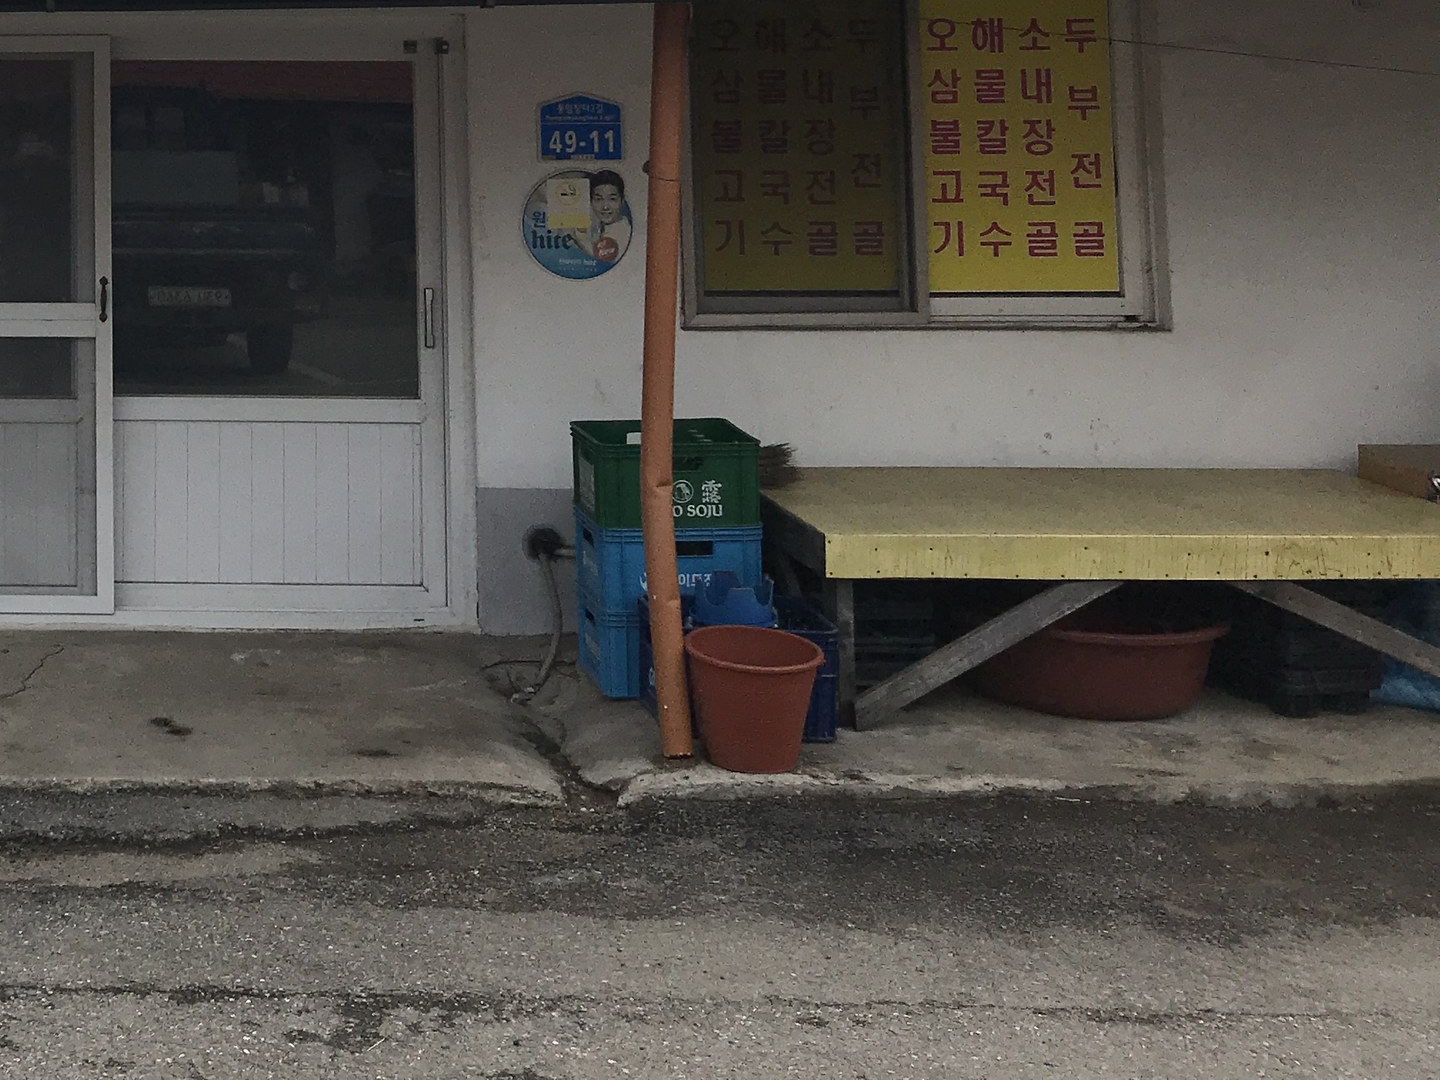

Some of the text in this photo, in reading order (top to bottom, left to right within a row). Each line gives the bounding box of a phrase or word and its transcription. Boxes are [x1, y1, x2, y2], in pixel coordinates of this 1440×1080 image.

[531, 229, 572, 250] hite
[549, 130, 614, 153] 49-11
[926, 18, 964, 258] 오삼불고기
[971, 18, 1013, 258] 해물칼국수
[1018, 18, 1059, 258] 소내장전골
[1064, 18, 1106, 258] 두부전골
[687, 504, 723, 519] SOJU
